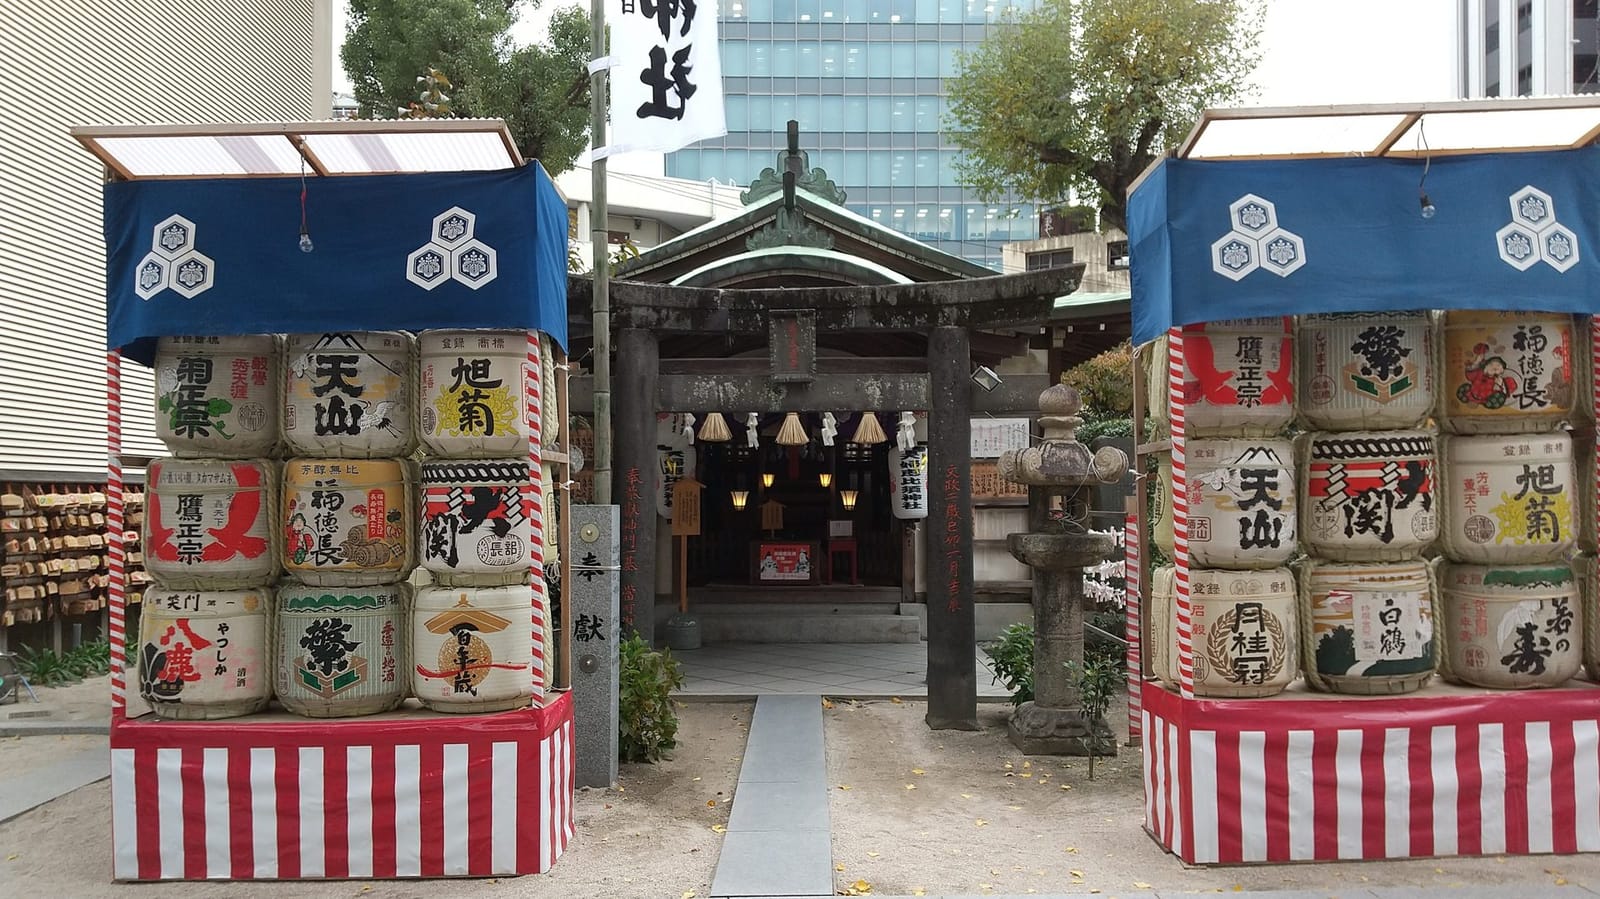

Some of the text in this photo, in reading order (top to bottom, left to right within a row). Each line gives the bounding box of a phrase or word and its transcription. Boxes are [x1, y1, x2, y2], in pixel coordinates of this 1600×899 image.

[313, 354, 364, 436] 天山
[449, 357, 503, 437] 旭菊
[1235, 336, 1263, 408] 鷹正宗
[1512, 325, 1547, 409] 福徳長
[175, 494, 204, 565] 鷹正宗
[311, 479, 345, 566] 福徳長
[1237, 468, 1282, 550] 天山
[1514, 464, 1563, 542] 旭菊
[157, 618, 213, 682] 八鹿
[214, 622, 230, 676] やつしか
[1230, 602, 1270, 685] 月桂冠
[1379, 599, 1406, 656] 白鶴
